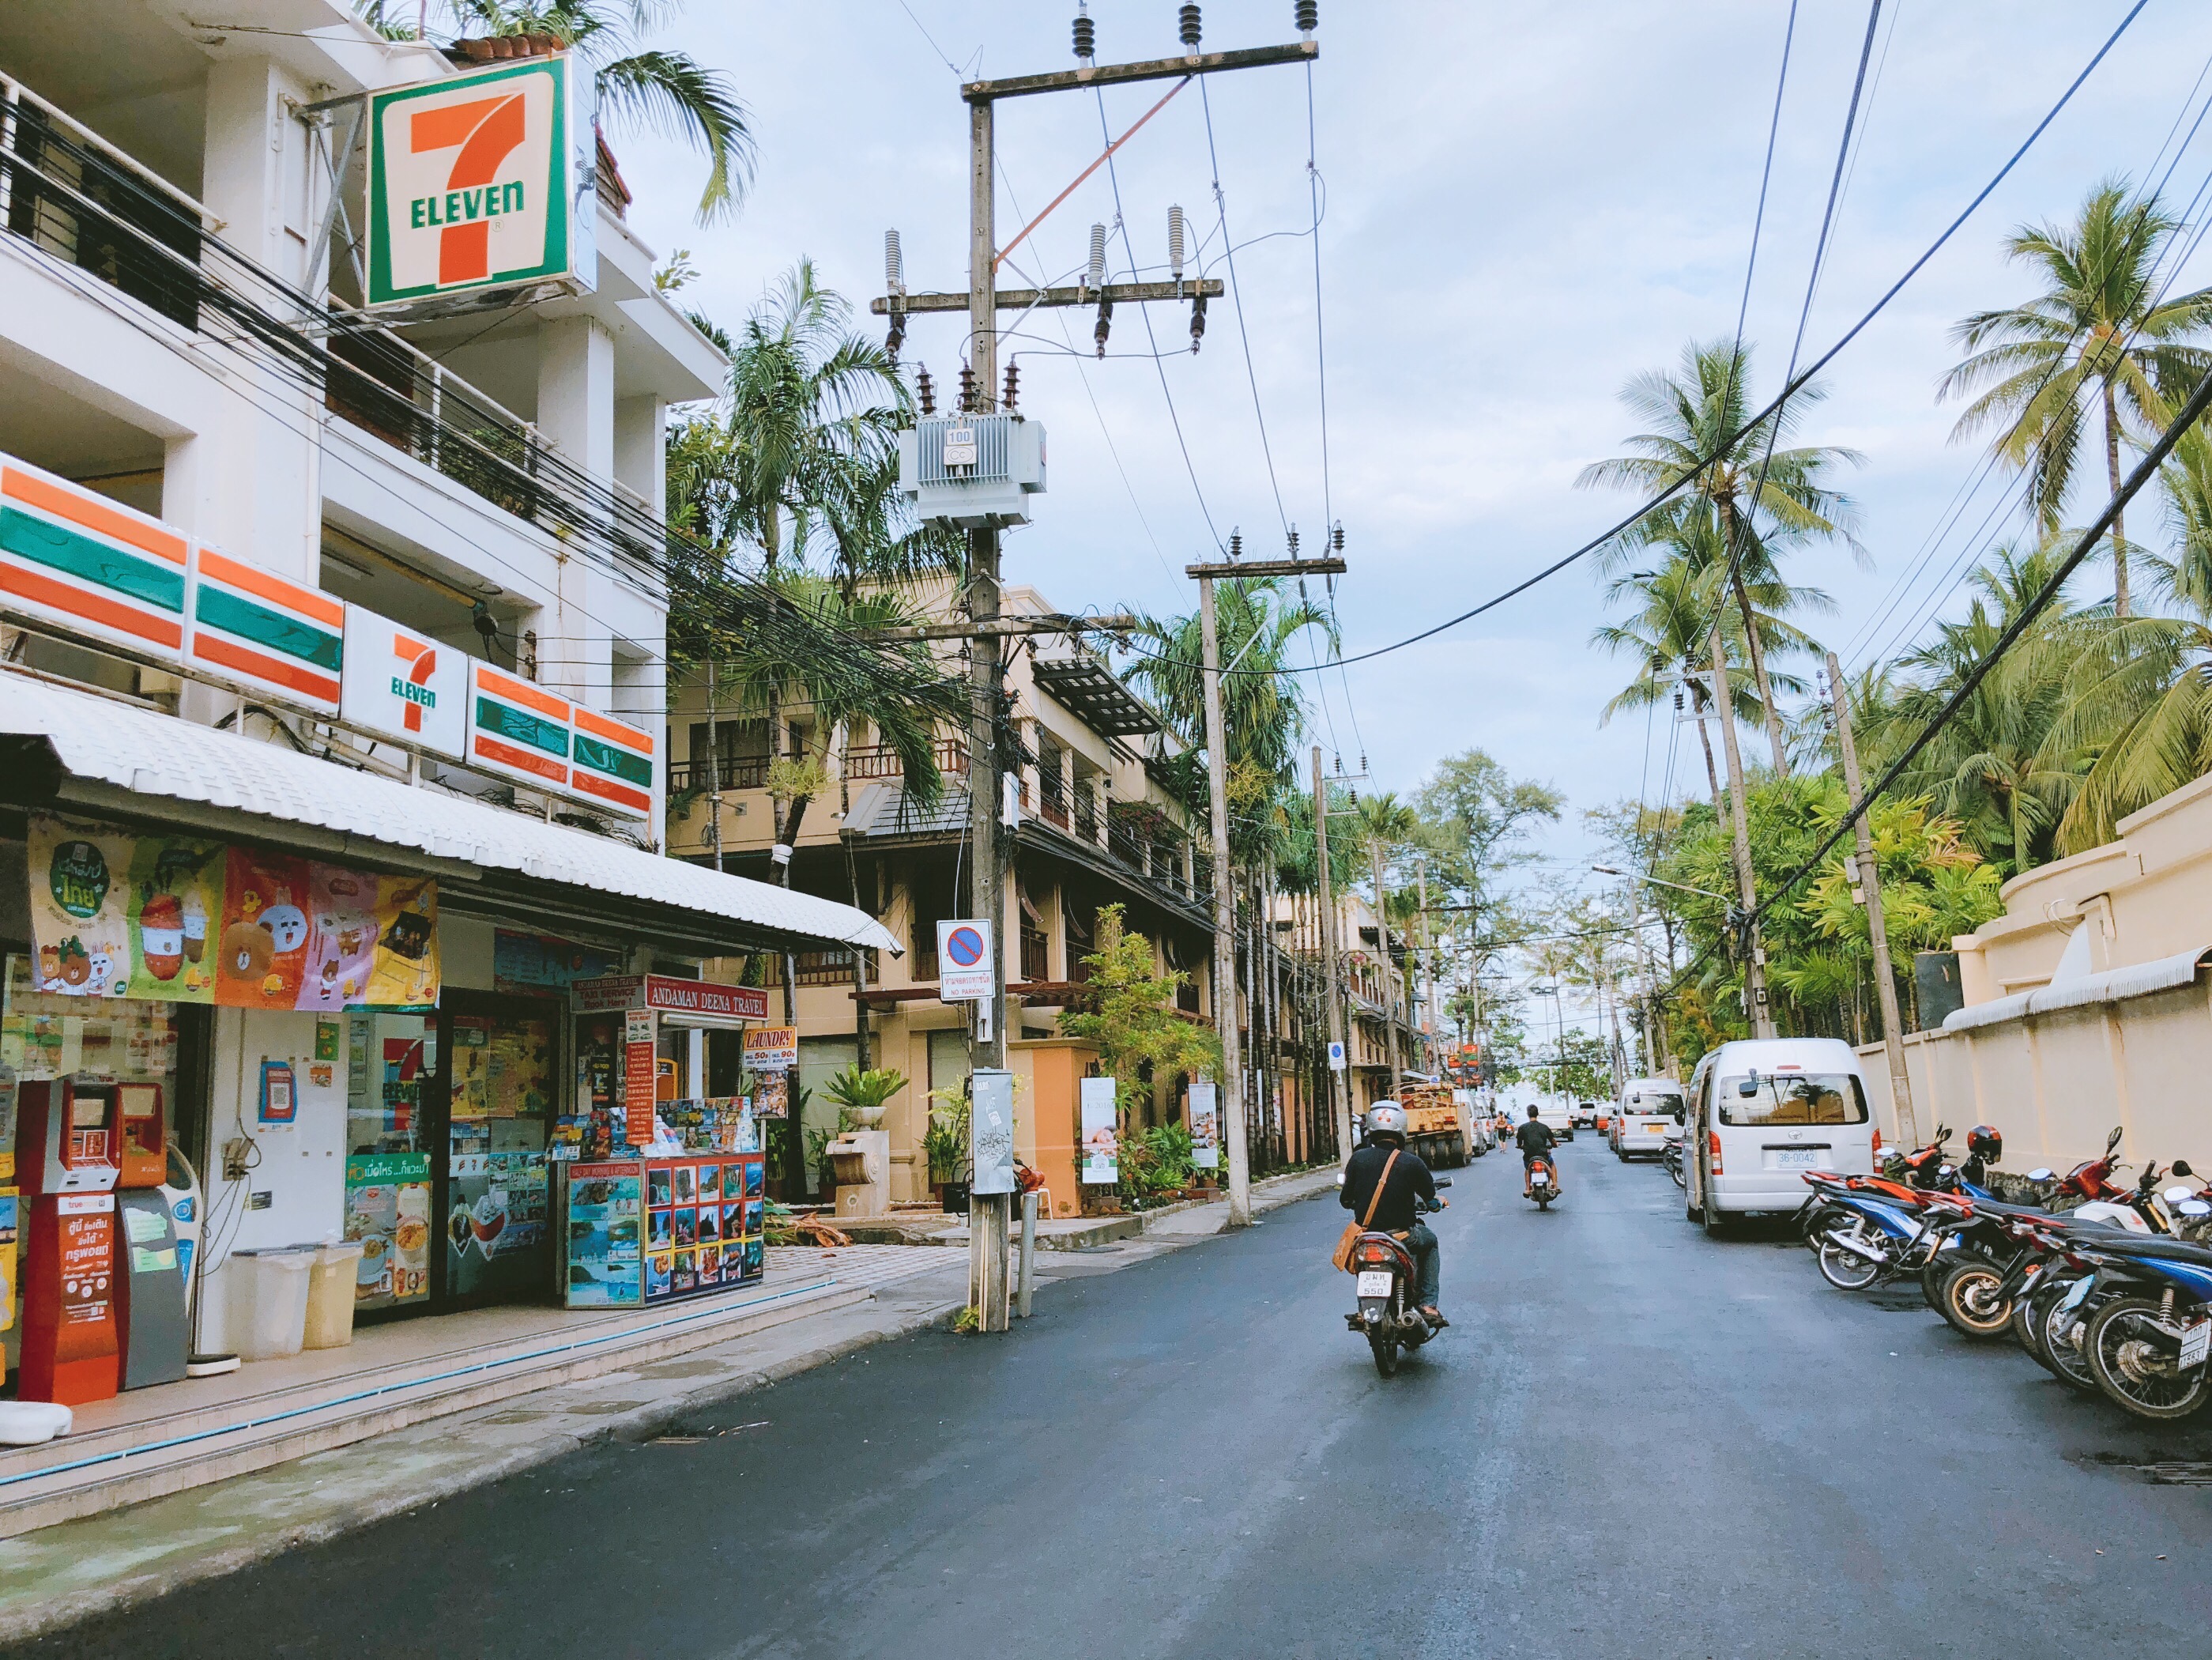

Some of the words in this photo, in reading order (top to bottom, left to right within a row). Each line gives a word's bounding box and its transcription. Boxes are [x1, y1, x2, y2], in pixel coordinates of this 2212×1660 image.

[411, 92, 525, 285] 7
[949, 432, 970, 442] 100
[394, 632, 435, 732] 7
[601, 988, 636, 998] SERVICE
[651, 987, 698, 1009] ANDAMAN
[701, 993, 731, 1011] DEENA
[733, 996, 765, 1015] TRAVEL
[747, 1030, 793, 1048] LAUNDRY
[1778, 1153, 1815, 1163] 36-0042
